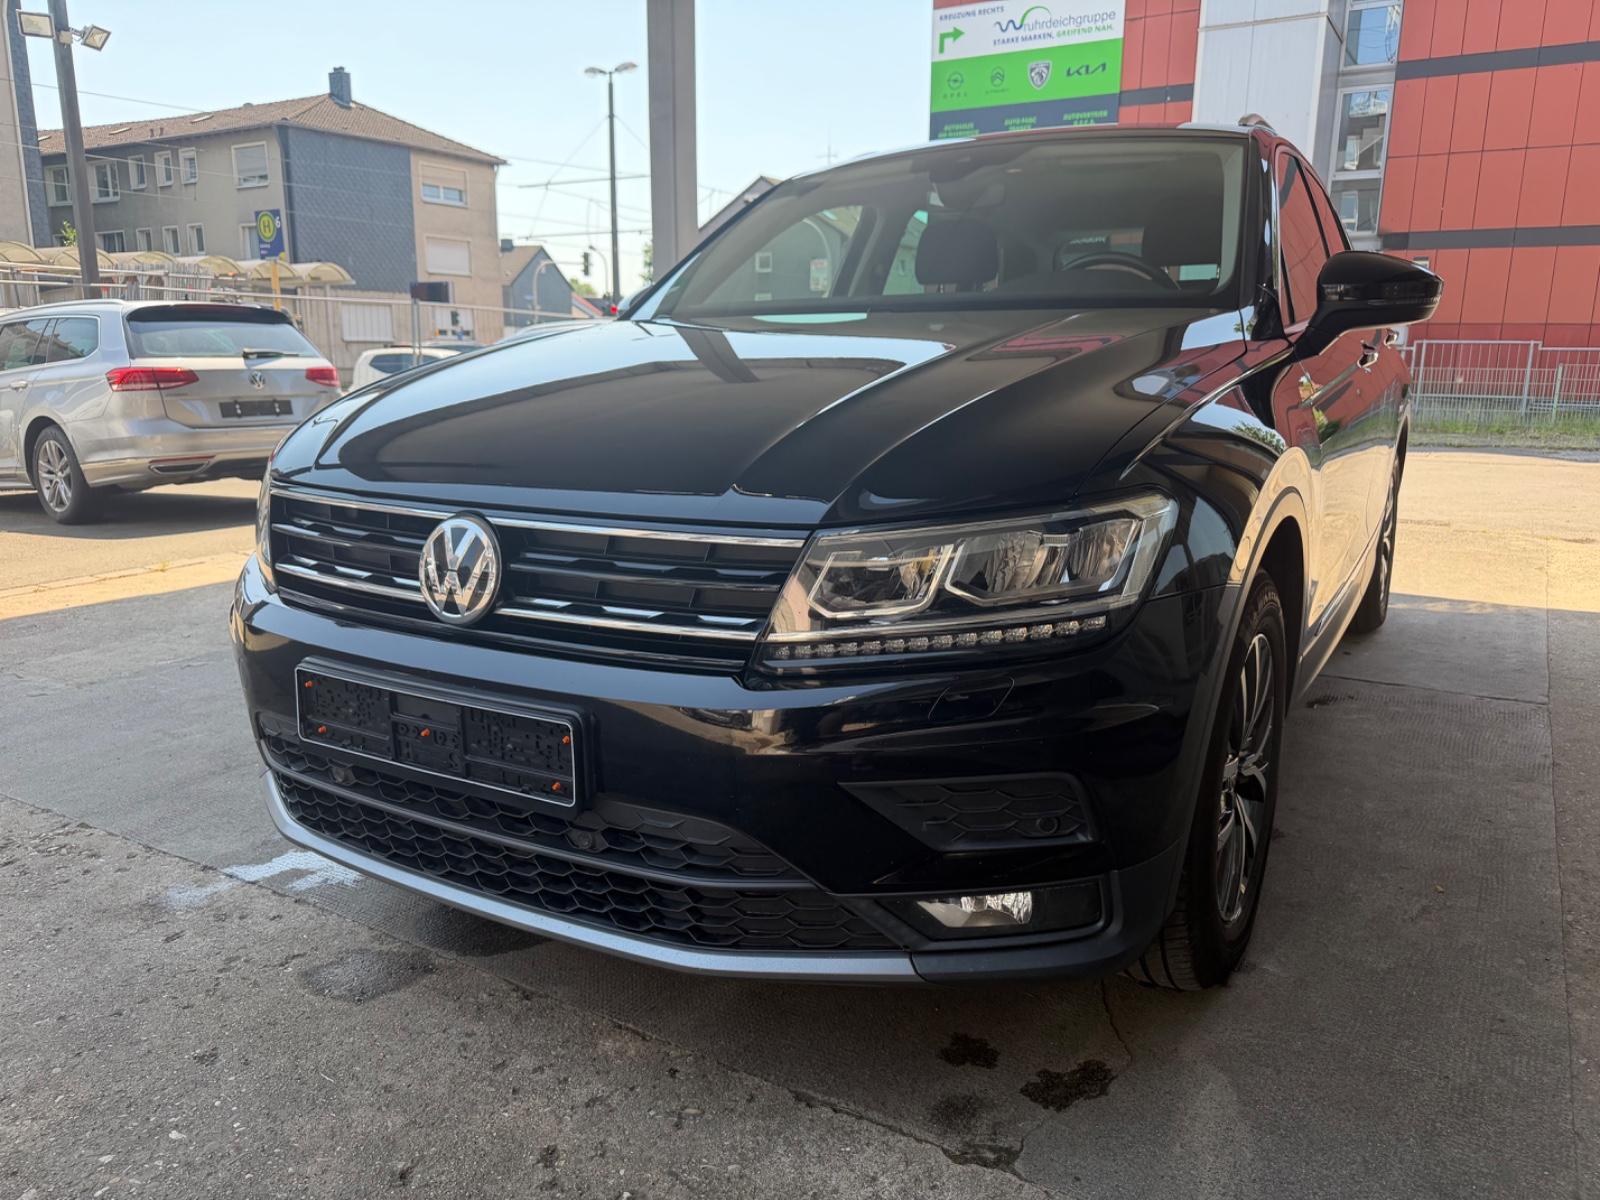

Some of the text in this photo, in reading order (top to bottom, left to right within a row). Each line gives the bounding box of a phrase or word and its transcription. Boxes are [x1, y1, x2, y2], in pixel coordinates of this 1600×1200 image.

[939, 6, 1004, 21] KREUZUNG RECHTS
[993, 37, 1019, 46] STARKE
[1066, 62, 1107, 77] KIA
